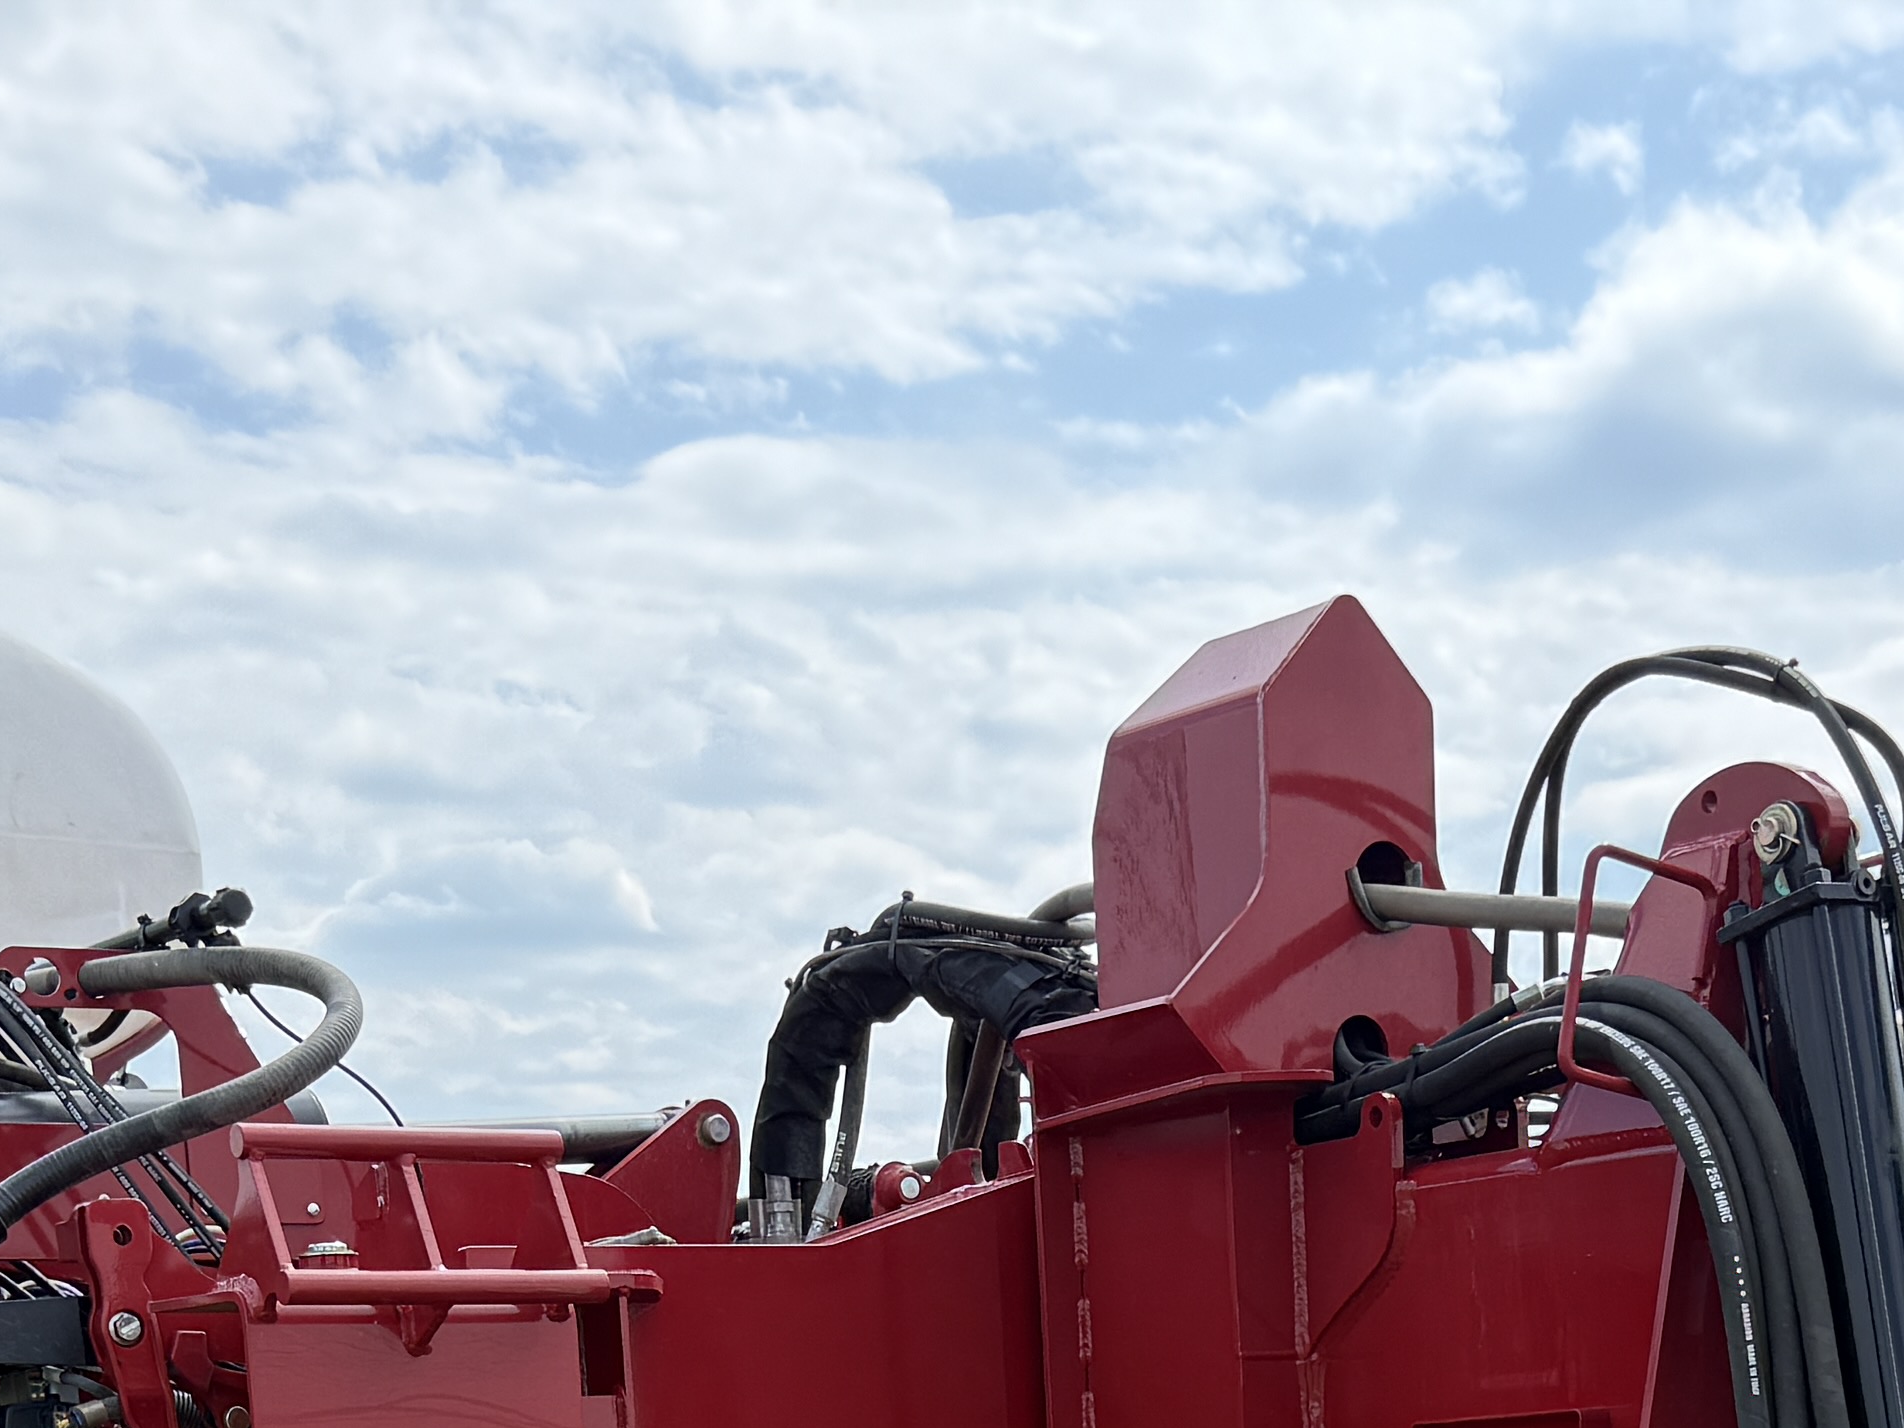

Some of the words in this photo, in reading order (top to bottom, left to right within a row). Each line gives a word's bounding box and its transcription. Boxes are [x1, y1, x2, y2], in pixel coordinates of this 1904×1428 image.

[1630, 1046, 1650, 1063] SAE
[1645, 1056, 1676, 1091] 100R17
[1672, 1096, 1692, 1117] SAE
[1684, 1115, 1711, 1159] 100R16
[1706, 1168, 1723, 1189] 2SC
[1714, 1190, 1733, 1224] HARC
